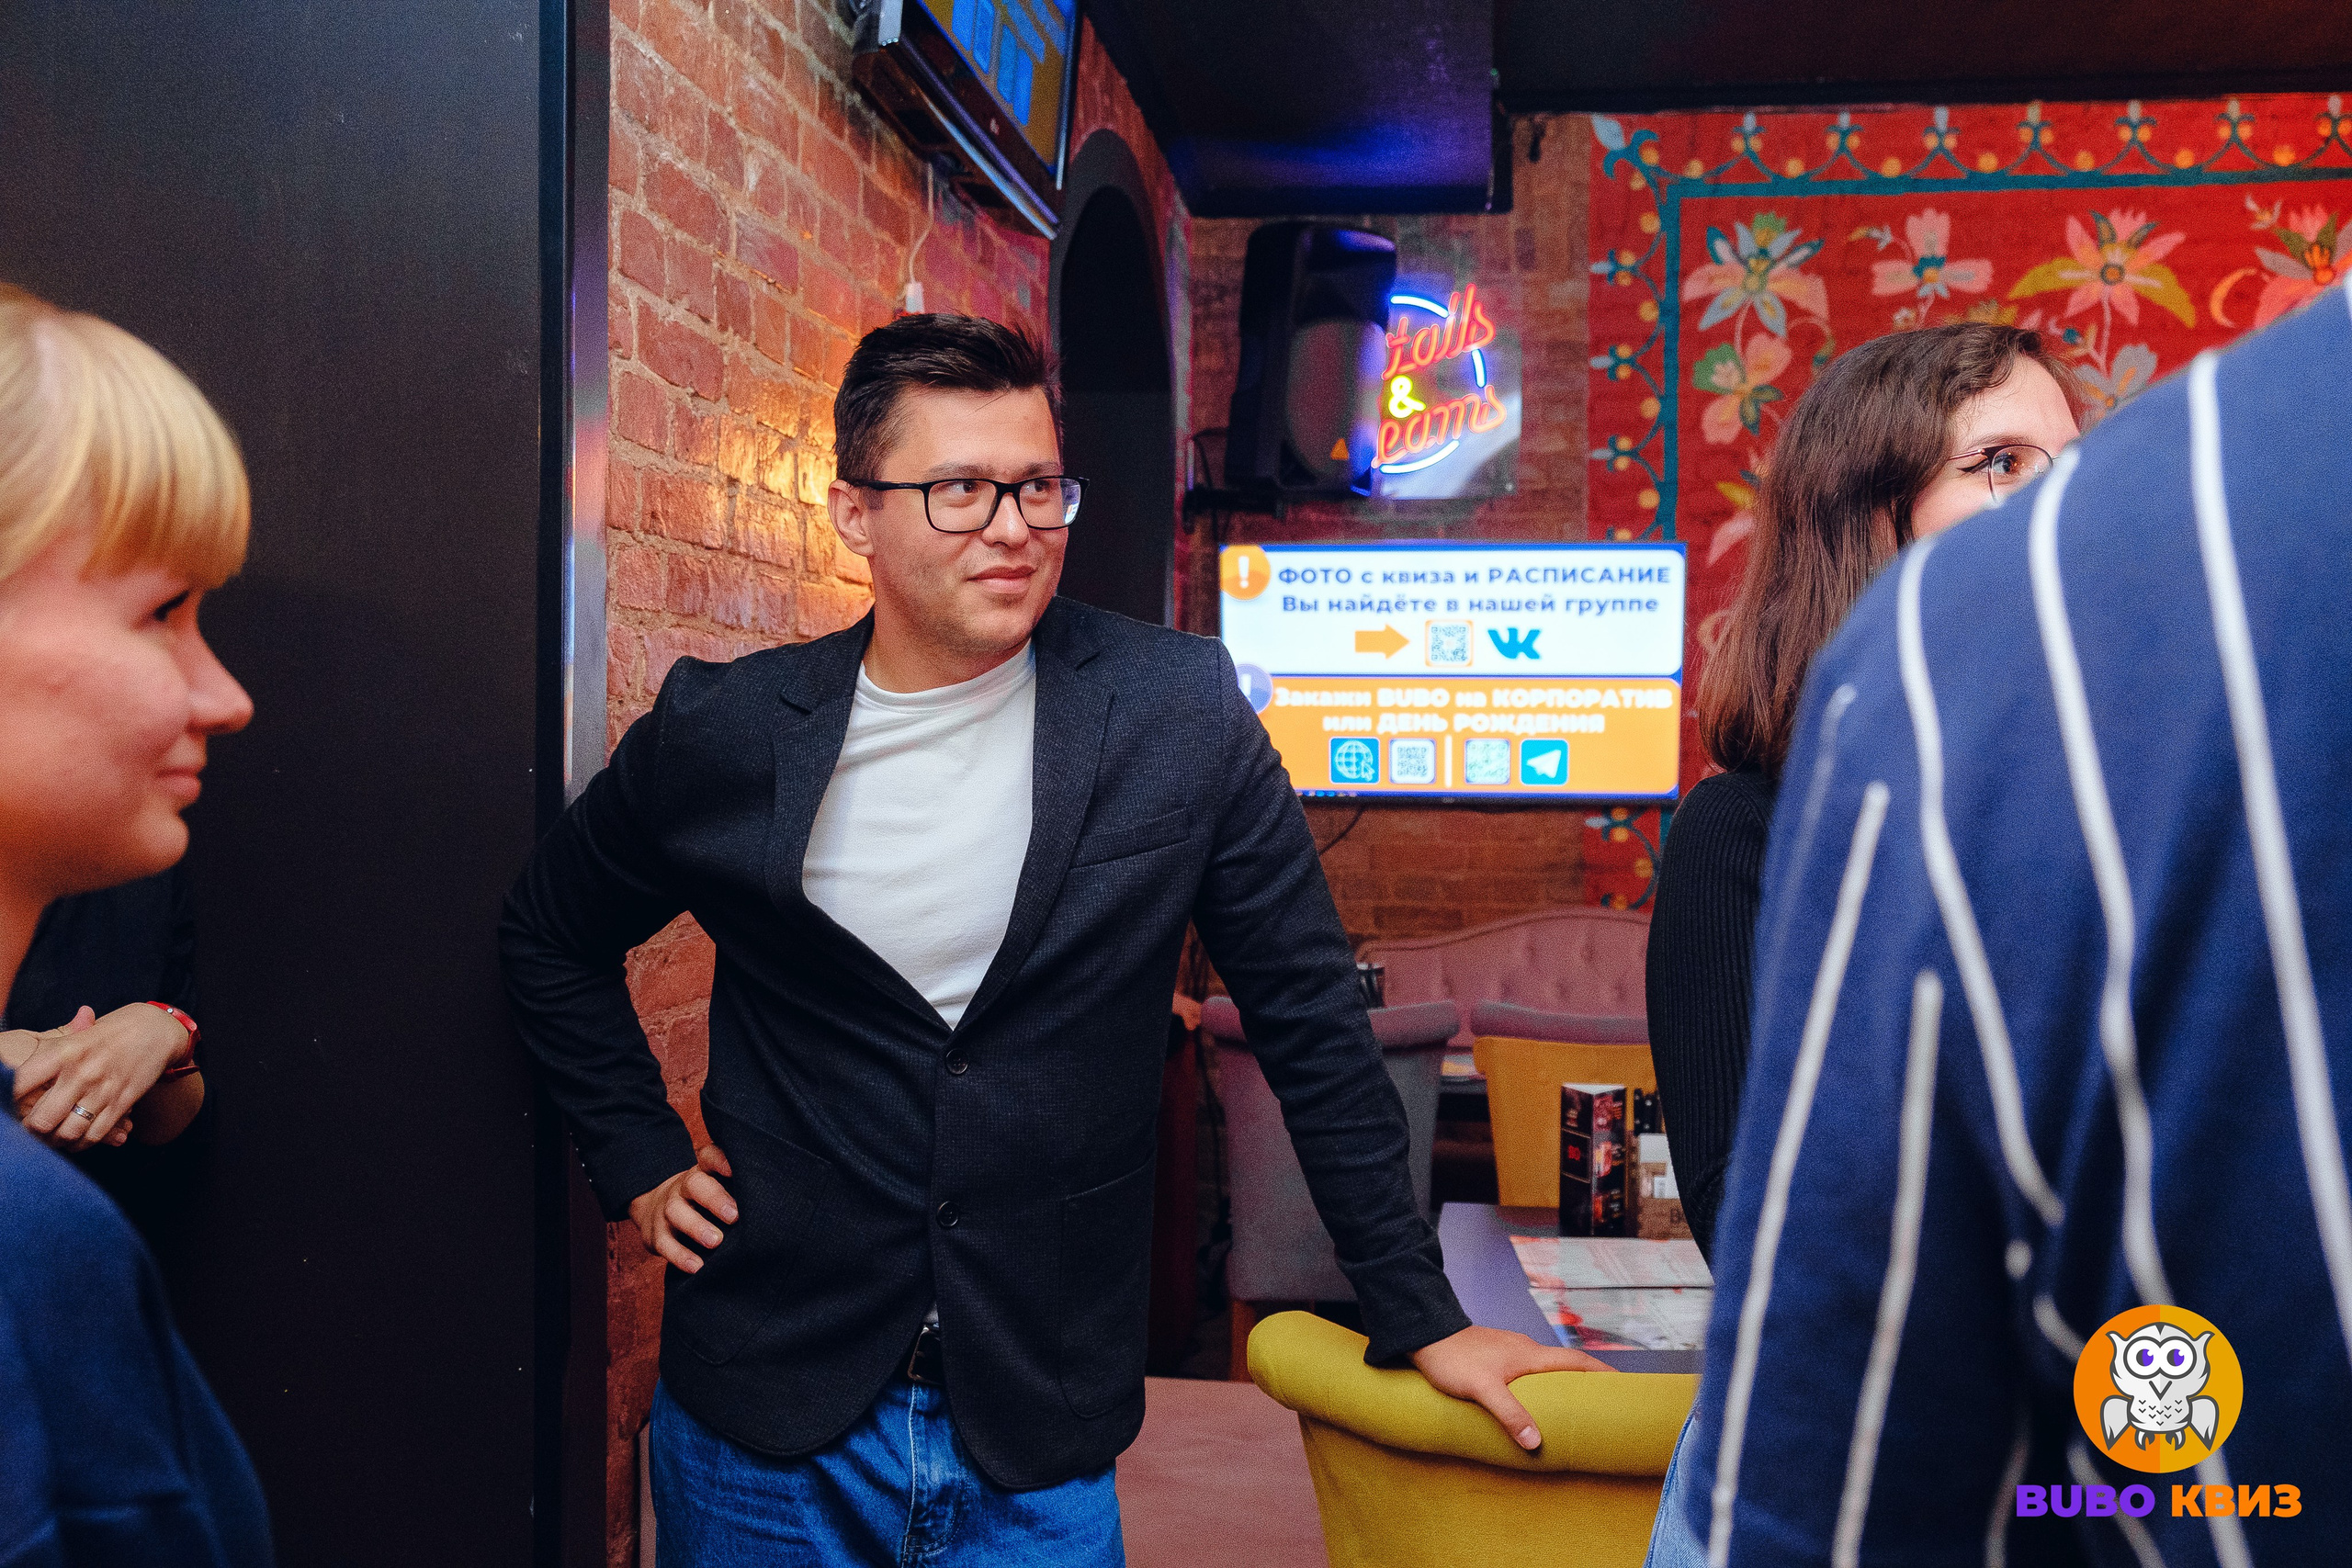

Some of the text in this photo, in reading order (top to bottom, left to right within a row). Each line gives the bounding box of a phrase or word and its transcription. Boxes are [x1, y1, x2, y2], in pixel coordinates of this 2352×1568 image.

[1382, 283, 1496, 380] tails
[1388, 375, 1427, 419] &
[1372, 385, 1507, 468] eams
[1279, 567, 1671, 584] ФОТО с квиза и РАСПИСАНИЕ
[1283, 593, 1659, 615] Вы найдёте в нашей группе
[1274, 687, 1673, 709] Закажи BUBO на КОРПОРАТИВ
[1323, 713, 1605, 736] или ДЕНЬ РОЖДЕНИЯ
